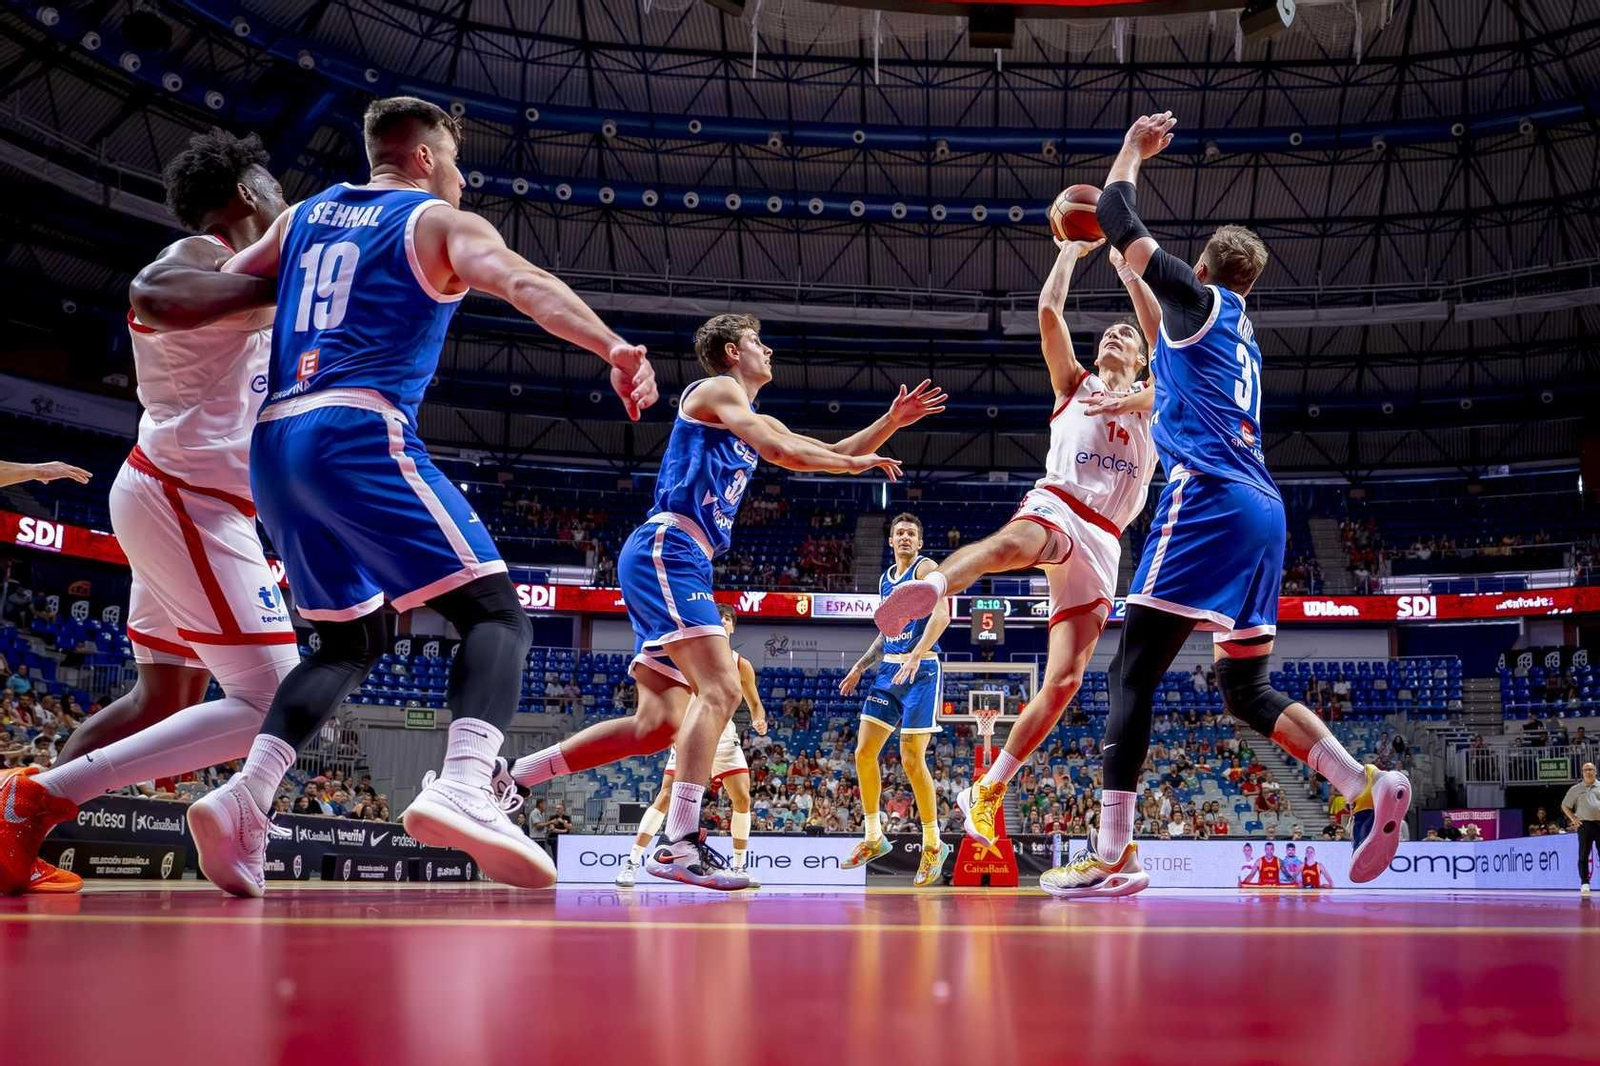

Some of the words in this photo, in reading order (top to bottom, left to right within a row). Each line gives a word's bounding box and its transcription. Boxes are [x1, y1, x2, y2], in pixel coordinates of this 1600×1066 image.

[307, 201, 384, 228] SEHNAL
[294, 241, 361, 332] 19
[1234, 343, 1262, 423] 31
[1106, 421, 1130, 446] 14
[16, 516, 64, 549] SDI
[517, 585, 556, 607] SDI
[825, 599, 873, 613] ESPAÑA
[976, 599, 1000, 610] 8:10
[1396, 594, 1437, 617] SDI
[982, 612, 994, 630] 5
[77, 808, 127, 829] endesa
[147, 815, 181, 832] CaixaBank
[391, 833, 417, 848] endesa
[803, 855, 840, 869] en
[963, 863, 1010, 874] CaixaBank
[1143, 857, 1192, 871] STORE
[1389, 853, 1490, 880] ompra
[1493, 847, 1534, 873] online
[1539, 850, 1560, 871] en
